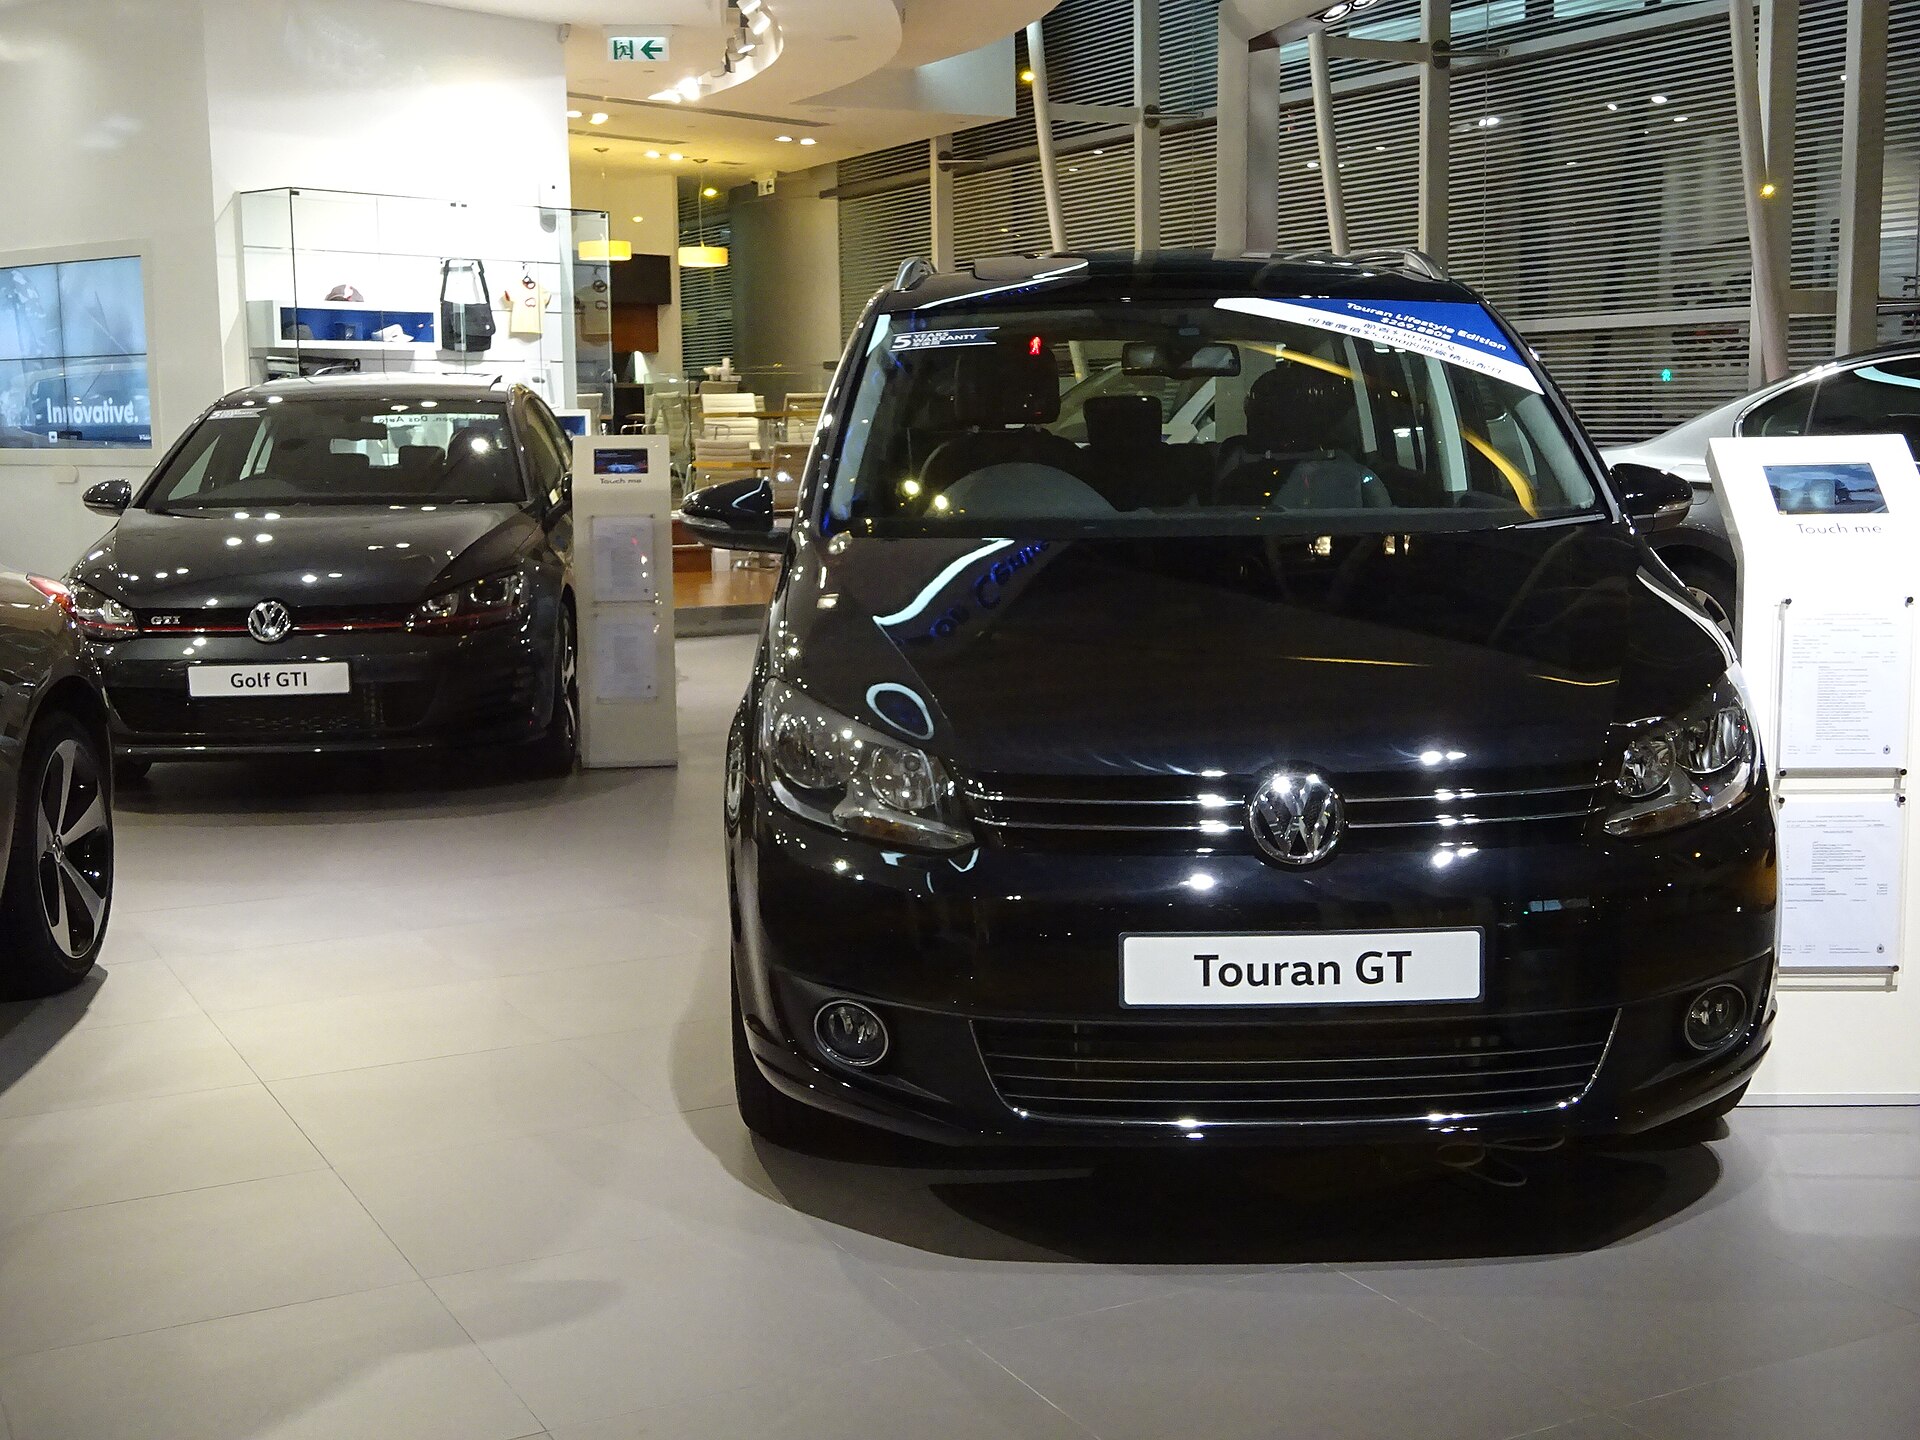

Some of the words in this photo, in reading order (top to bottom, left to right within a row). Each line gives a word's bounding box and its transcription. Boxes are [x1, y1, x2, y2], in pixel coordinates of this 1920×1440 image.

[1346, 302, 1393, 318] Touran
[1395, 313, 1455, 334] Lifestyle
[1457, 329, 1508, 351] Edition
[892, 334, 912, 349] 5
[912, 334, 977, 344] WARRANTY
[914, 331, 949, 339] YEARS
[46, 397, 139, 424] Innovative.
[1796, 523, 1849, 534] Touch
[1855, 526, 1882, 534] me
[150, 615, 181, 625] GTI
[230, 672, 270, 688] Golf
[276, 672, 308, 687] GTI
[1193, 953, 1341, 987] Touran
[1355, 950, 1412, 985] GT
